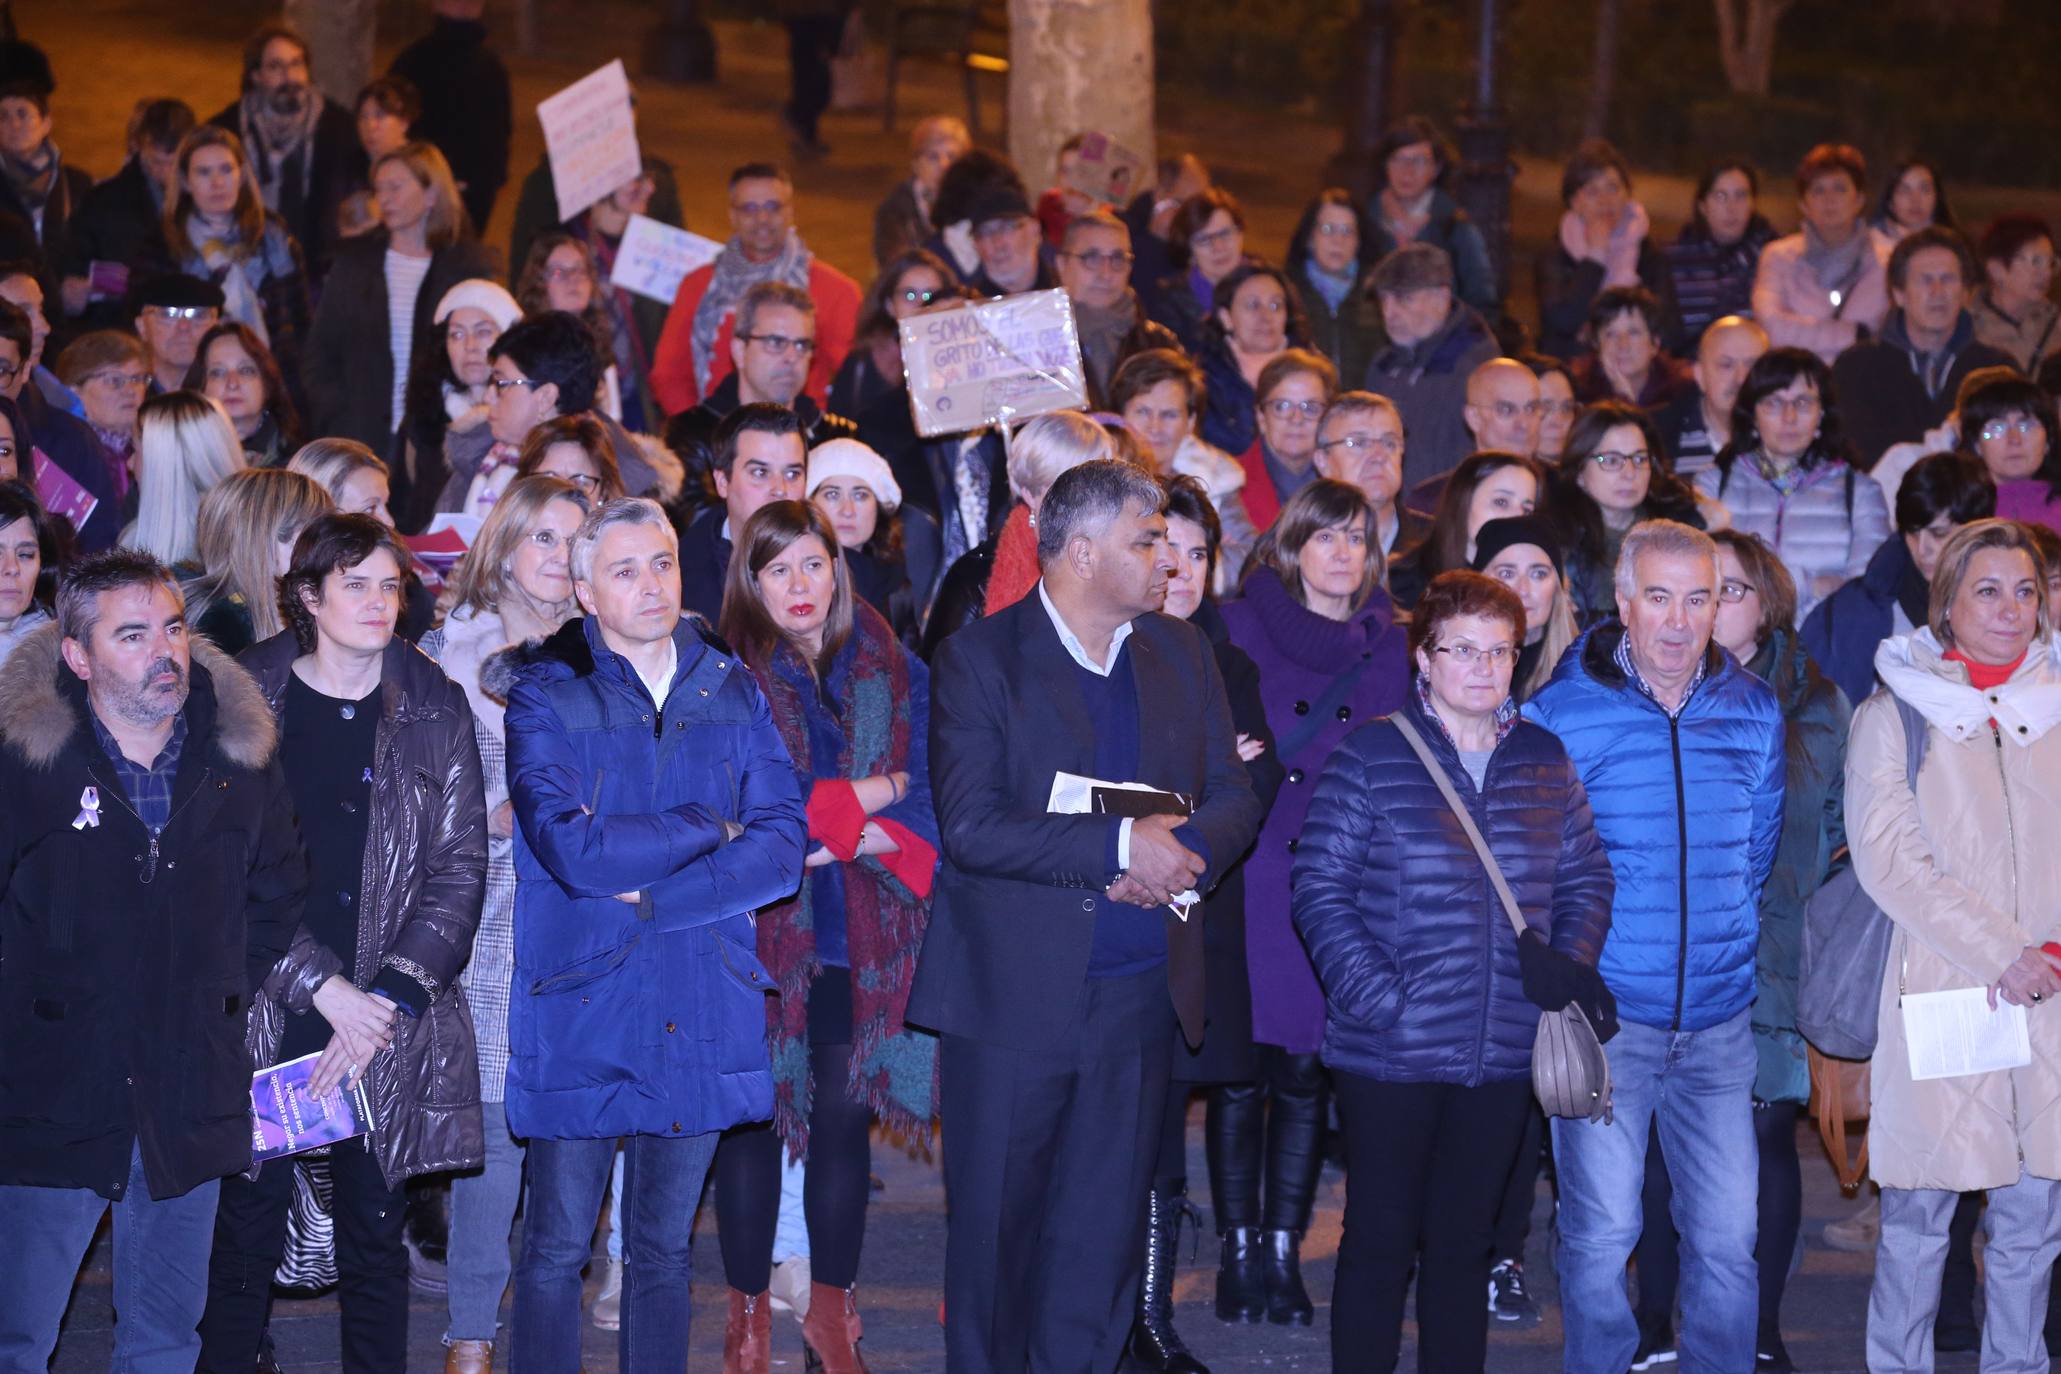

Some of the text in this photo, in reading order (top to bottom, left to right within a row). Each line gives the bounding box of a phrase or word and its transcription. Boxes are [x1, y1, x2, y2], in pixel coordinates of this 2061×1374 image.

[933, 341, 983, 367] GRITO
[281, 1113, 289, 1125] su
[286, 1082, 305, 1135] nos sentencia
[253, 1130, 268, 1152] 25N
[284, 1125, 297, 1151] Negar
